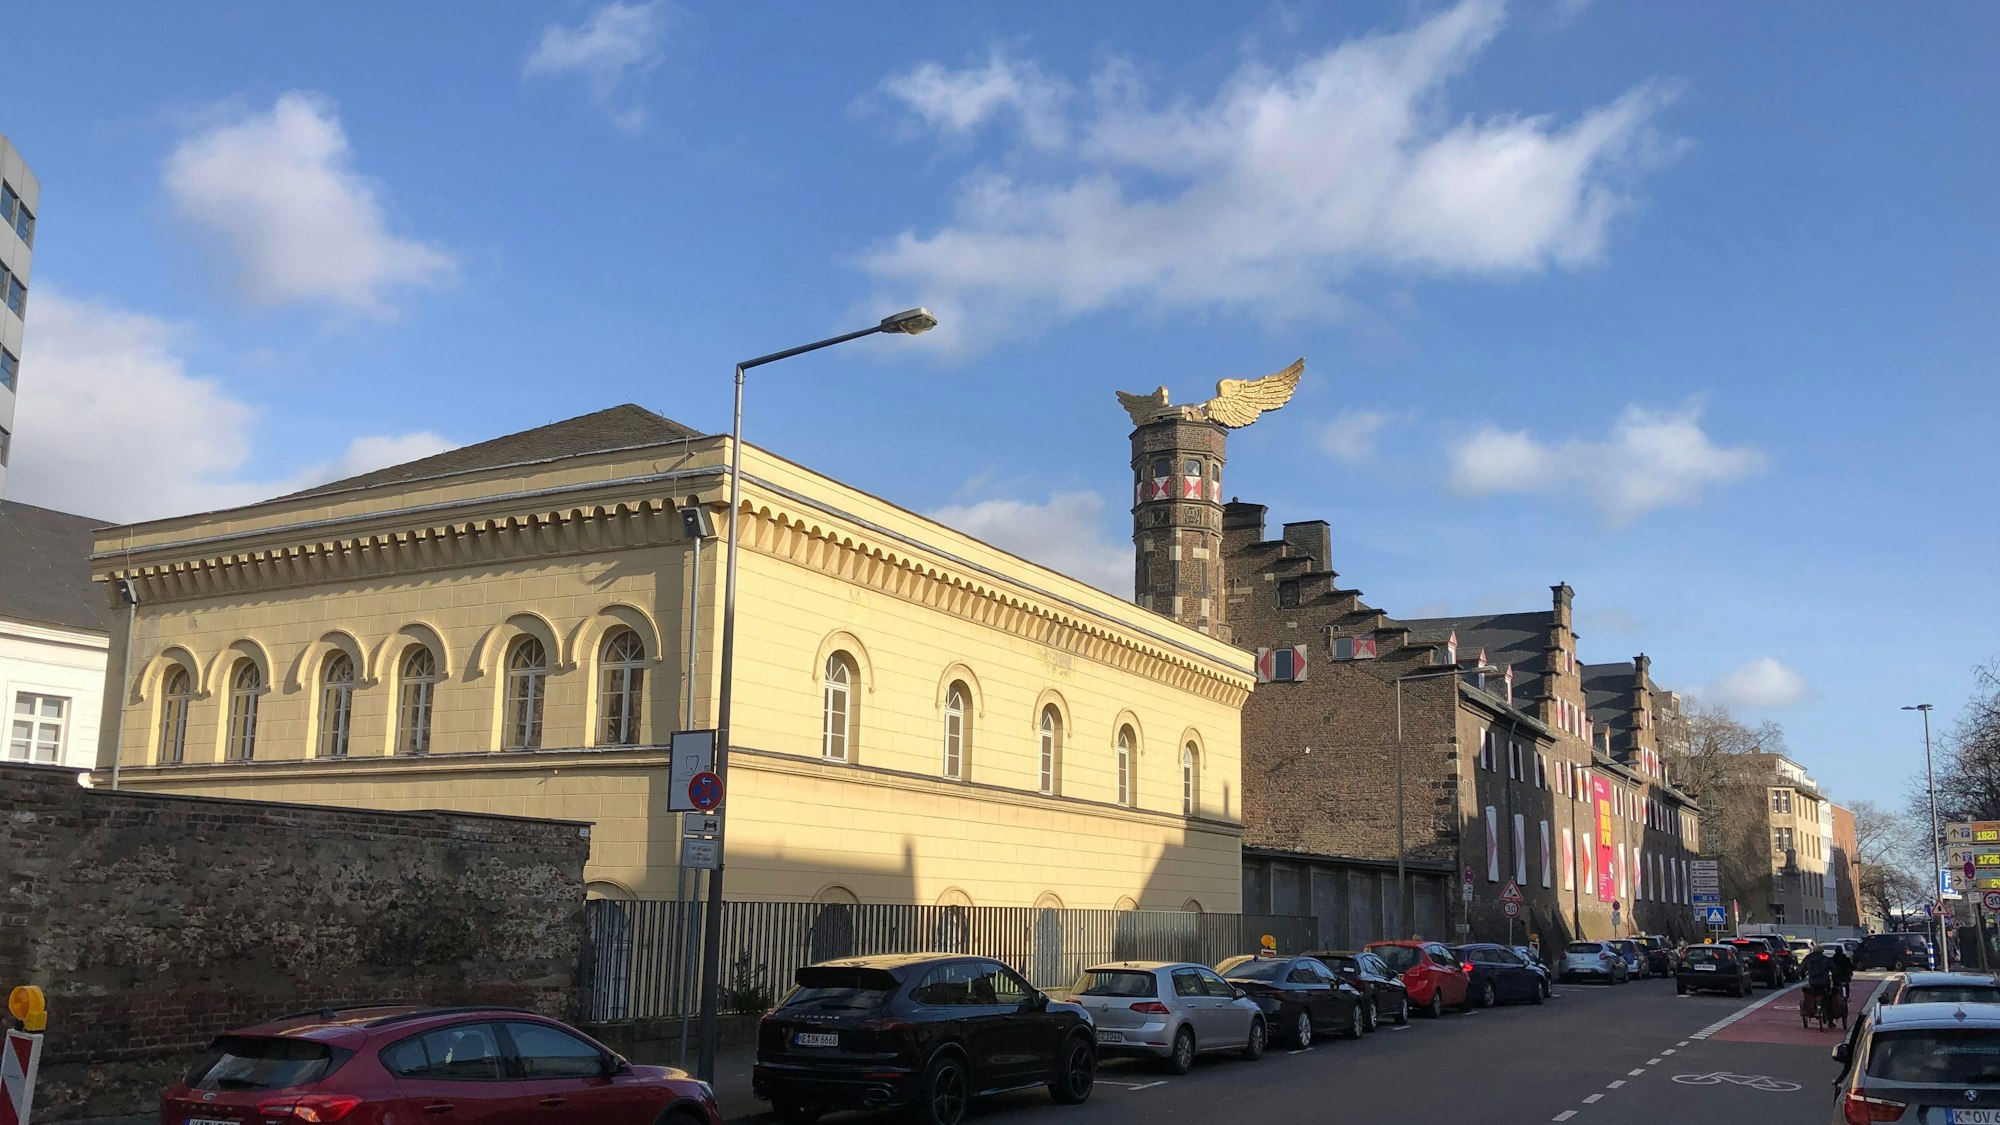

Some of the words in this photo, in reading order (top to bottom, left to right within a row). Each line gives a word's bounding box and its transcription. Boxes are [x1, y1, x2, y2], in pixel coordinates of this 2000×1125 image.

[1976, 831, 1998, 841] 1820
[1978, 855, 2000, 865] 1726
[1987, 896, 2000, 906] 30
[1506, 905, 1516, 913] 30
[1954, 1110, 1964, 1123] K
[1973, 1111, 1990, 1124] OV
